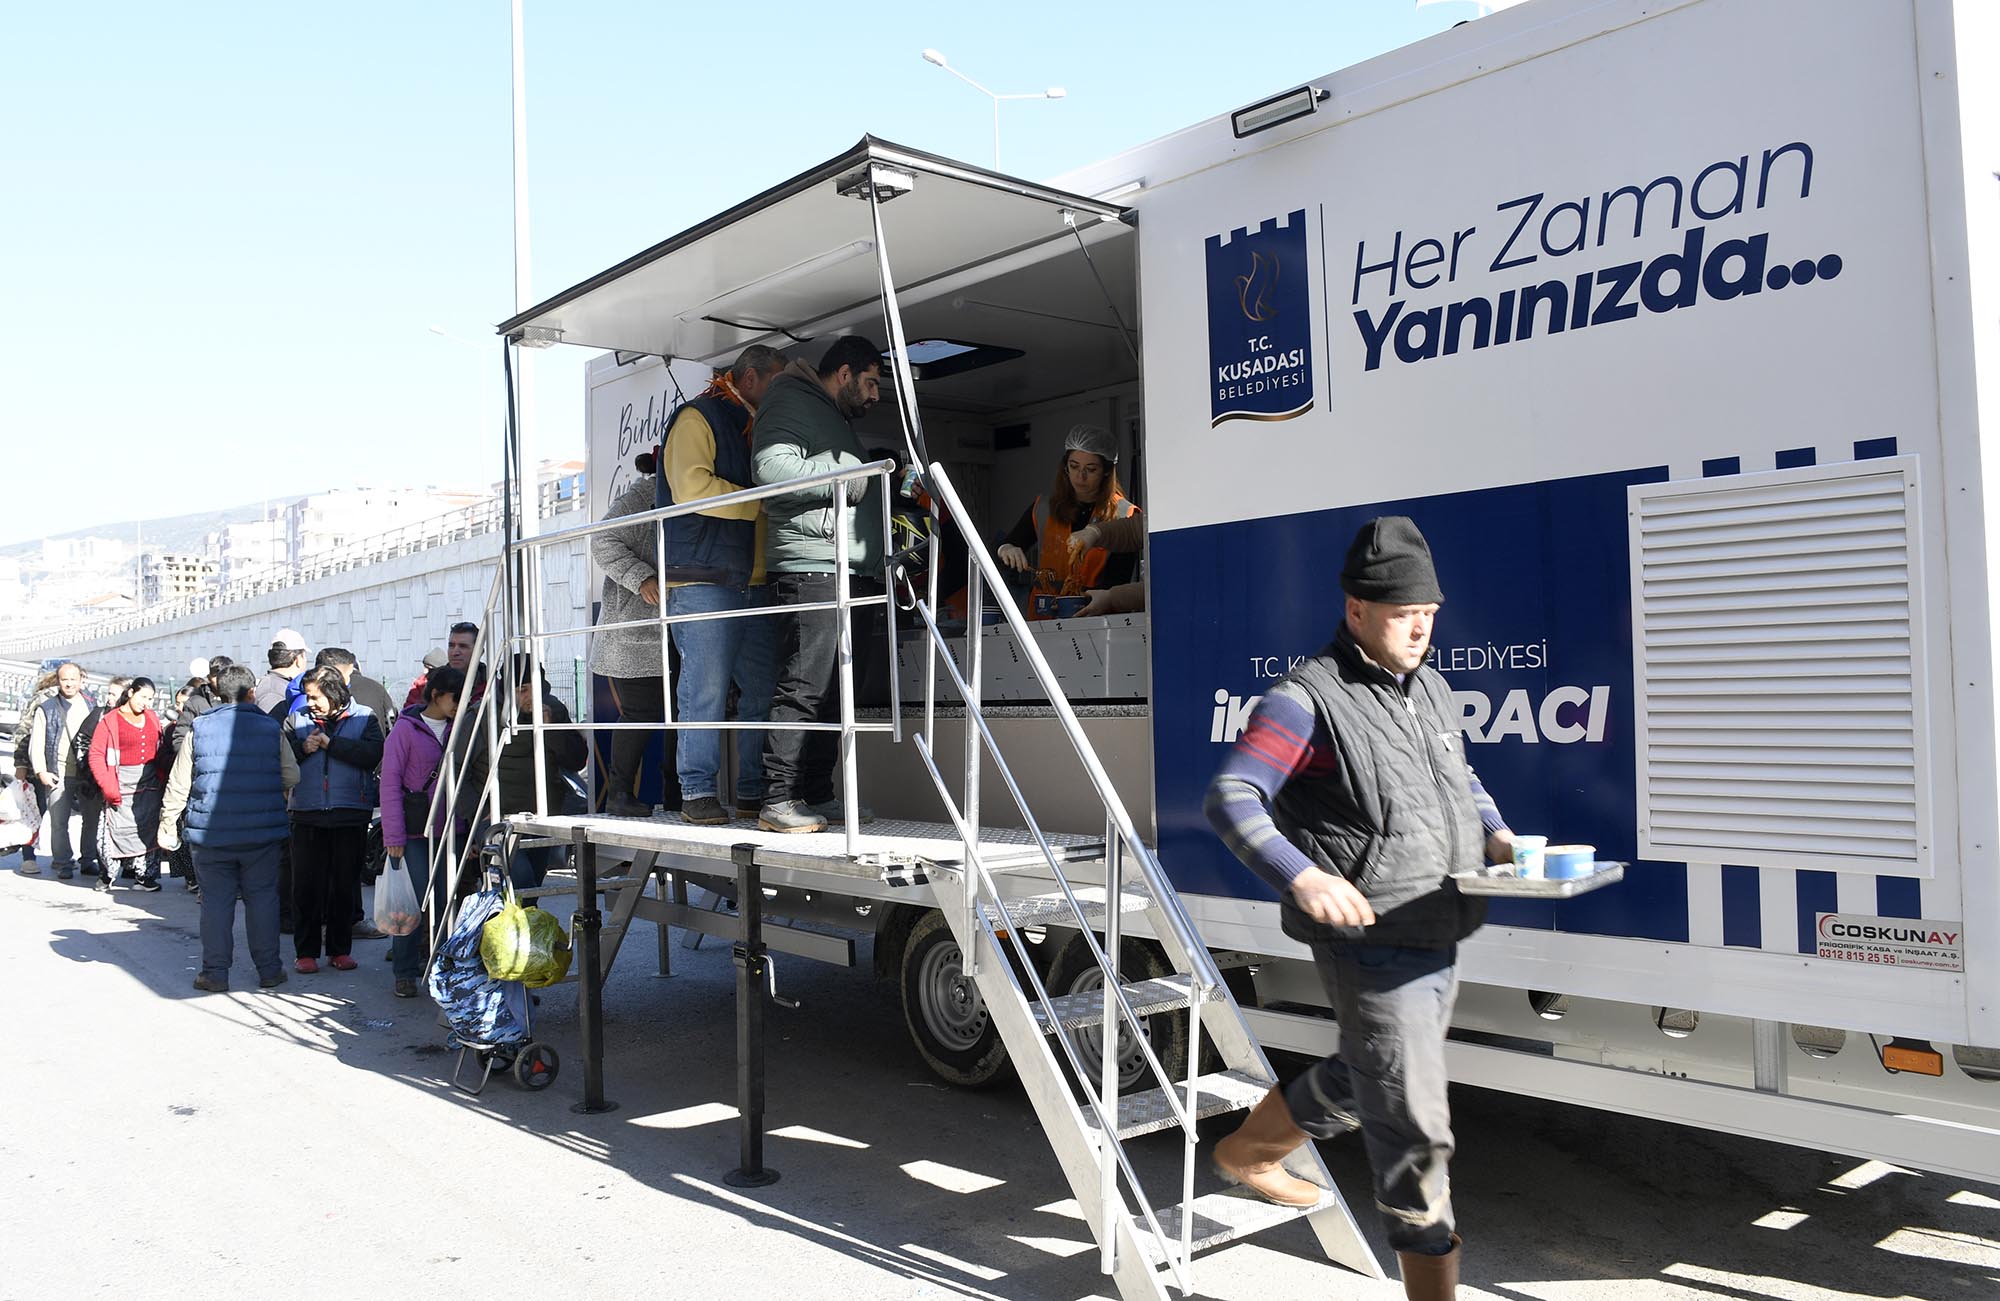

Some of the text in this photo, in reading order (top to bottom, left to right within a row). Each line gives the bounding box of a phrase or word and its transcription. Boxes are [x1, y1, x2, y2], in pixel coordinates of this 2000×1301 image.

[1352, 142, 1814, 305] Her Zaman
[1353, 226, 1843, 372] Yanınızda...
[1248, 335, 1273, 353] T.C.
[1218, 348, 1304, 383] KUŞADASI
[1219, 369, 1305, 401] BELEDİYESİ
[616, 388, 684, 461] Birlikt
[1250, 656, 1283, 678] T.C.
[1426, 638, 1547, 672] LEDİYESİ
[1450, 685, 1611, 744] RACI
[1819, 948, 1843, 959] 0312
[1846, 951, 1865, 961] 815
[1867, 952, 1880, 963] 25
[1883, 954, 1896, 965] 55
